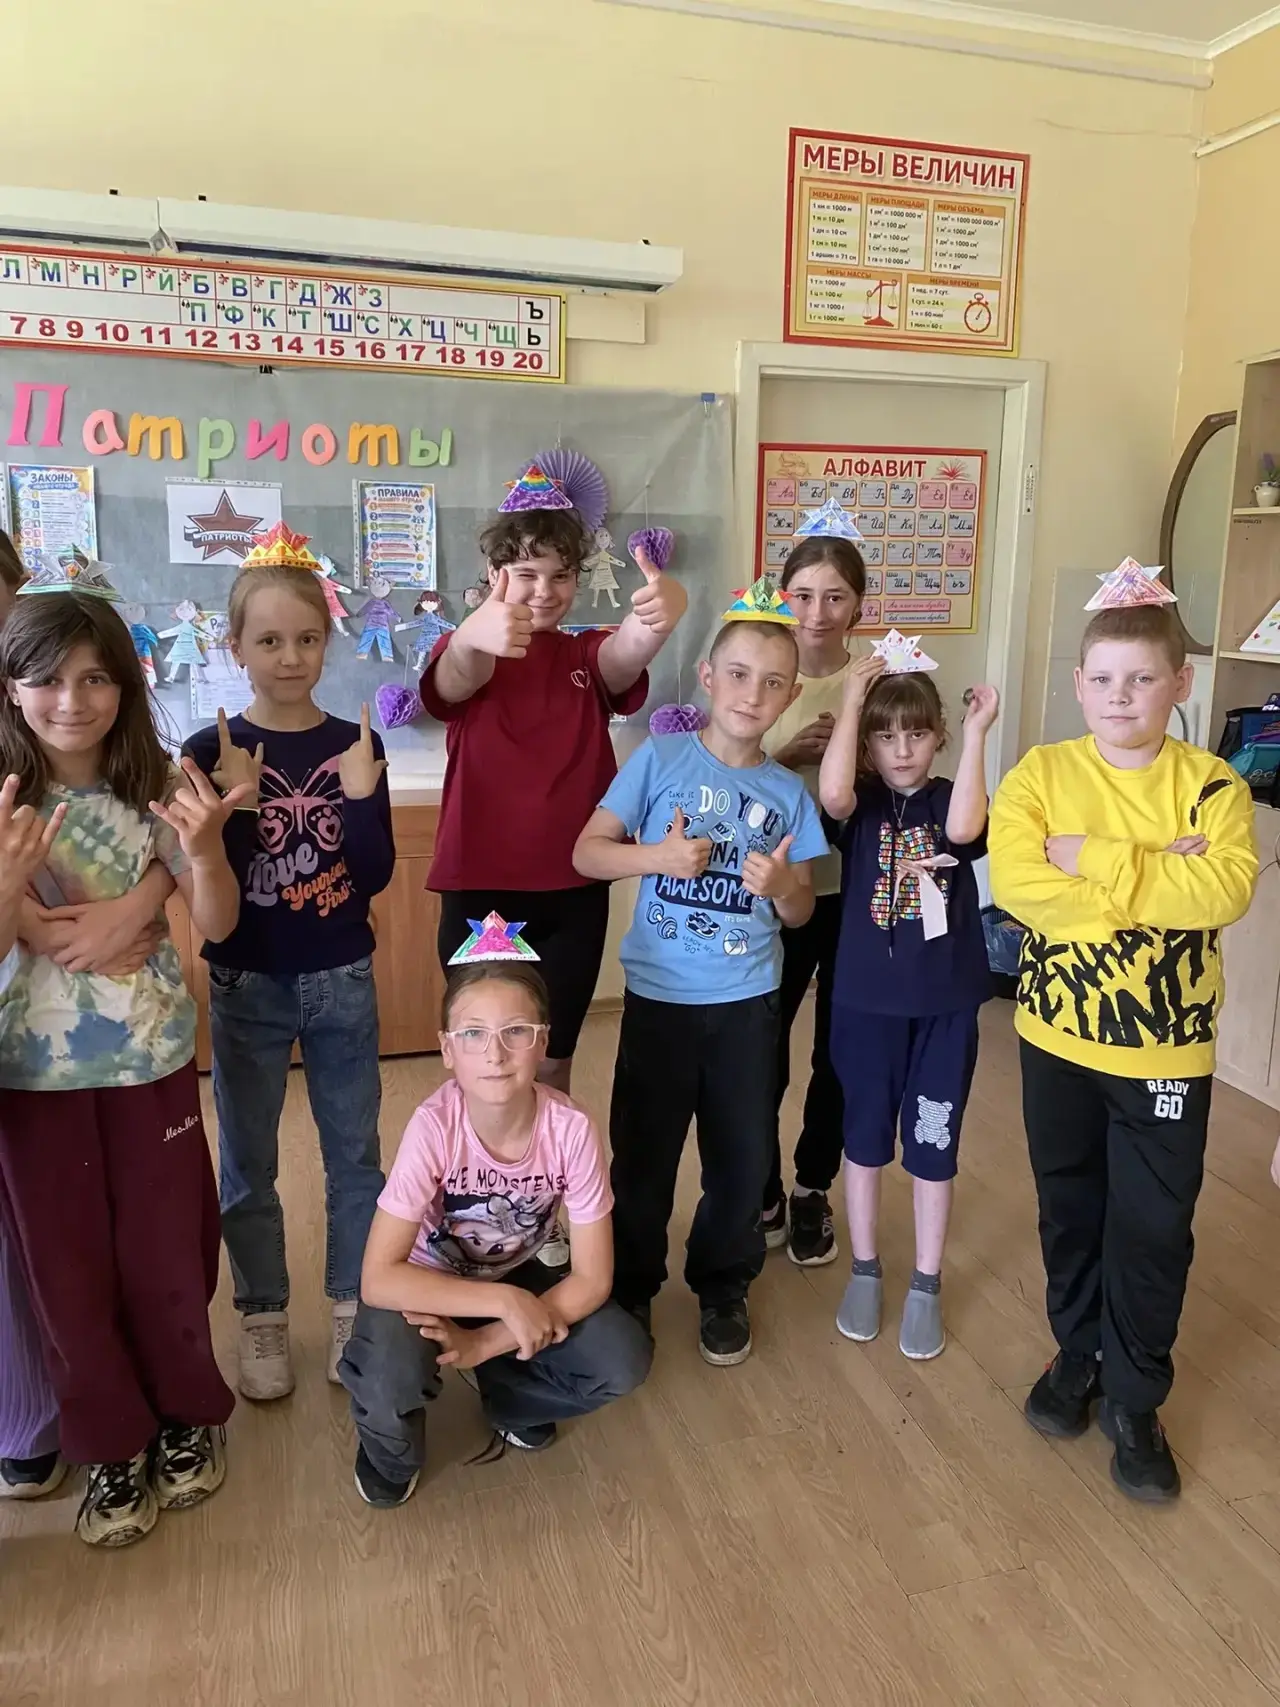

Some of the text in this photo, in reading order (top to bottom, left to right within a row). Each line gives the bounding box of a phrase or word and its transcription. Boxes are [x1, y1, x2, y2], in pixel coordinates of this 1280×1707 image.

[803, 143, 1016, 189] МЕРЫ ВЕЛИЧИН
[2, 258, 543, 320] Л М Н Р Й Б В Г Д Ж З Ъ
[190, 302, 541, 348] П Ф К Т Ш С Х Ц Ч Щ Ь
[10, 316, 542, 370] 7 8 9 10 11 12 13 14 15 16 17 18 19 20
[7, 382, 454, 478] Патриоты
[31, 472, 73, 483] ЗАКОНЫ
[823, 457, 926, 478] АЛФАВИТ
[378, 489, 420, 498] ПРАВИЛА
[202, 533, 252, 543] ПАТРИОТЫ
[698, 785, 782, 836] DO YOU
[1146, 1080, 1190, 1095] READY
[1154, 1094, 1184, 1120] GO
[447, 1166, 468, 1189] HE
